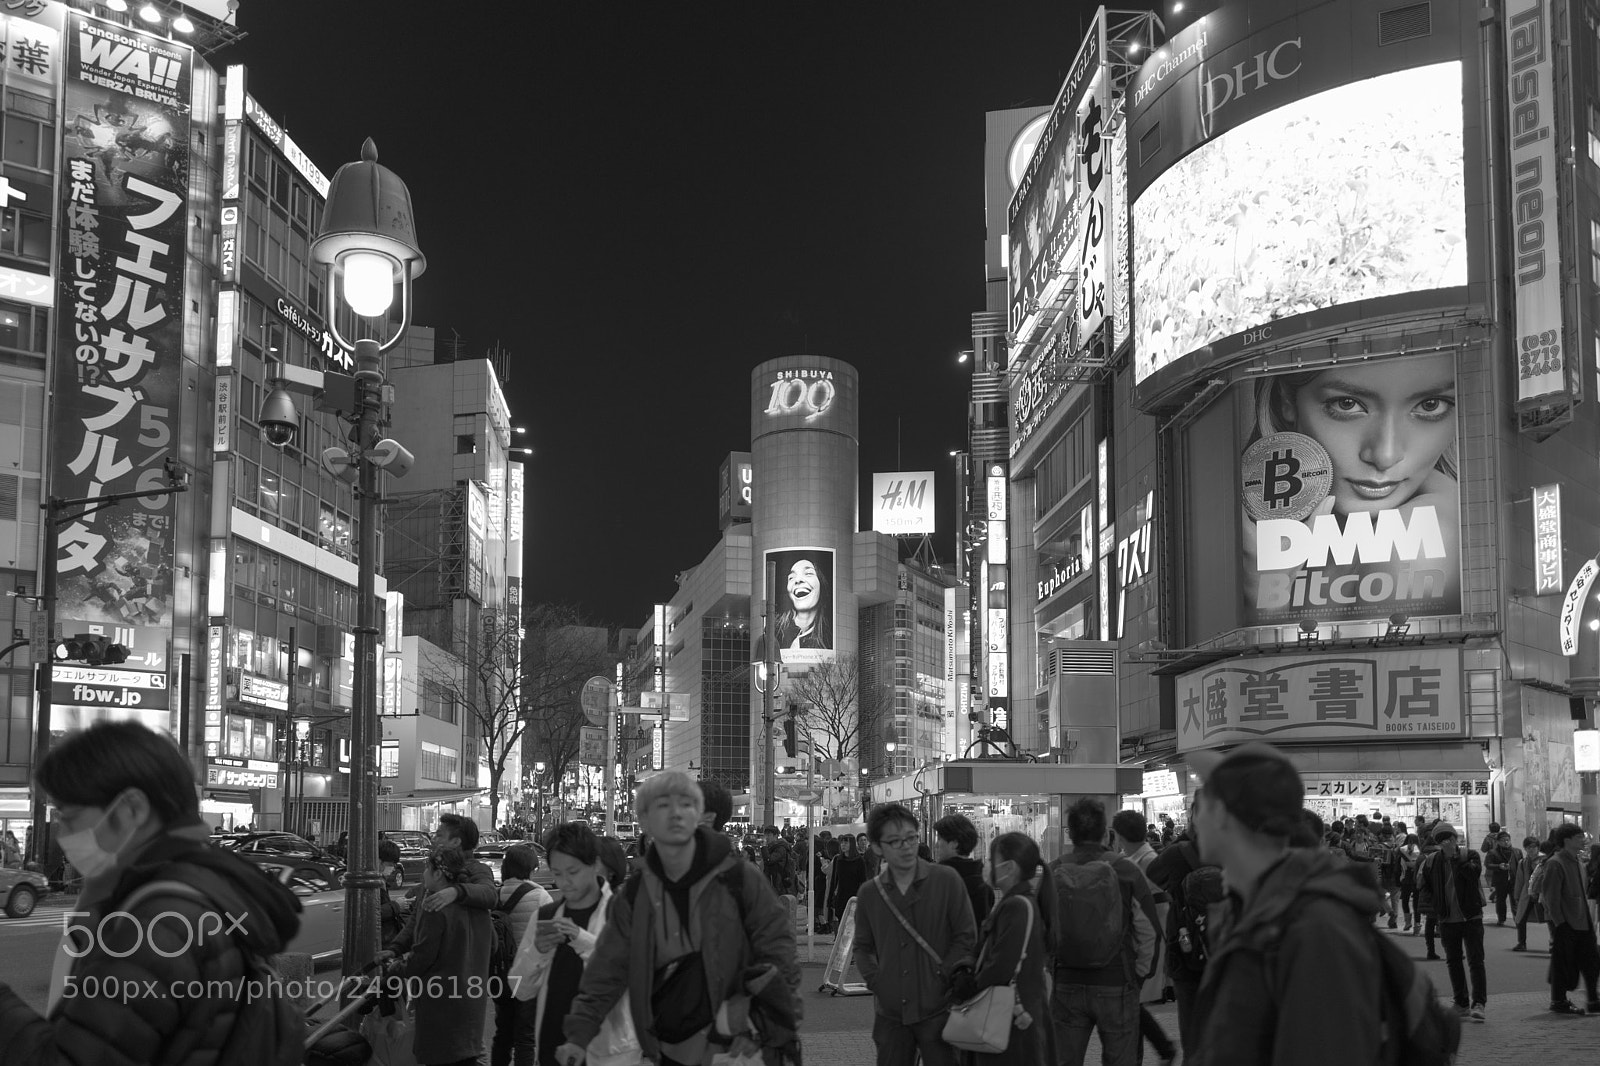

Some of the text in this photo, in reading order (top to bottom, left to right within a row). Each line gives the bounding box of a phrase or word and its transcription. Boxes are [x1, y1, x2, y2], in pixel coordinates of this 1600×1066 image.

[80, 20, 182, 61] Panasonic presents
[80, 63, 178, 98] Wonder Japan Experience
[1133, 32, 1207, 108] DHC Channel
[1203, 36, 1303, 118] DHC
[80, 71, 179, 107] FUERZA BRUTA
[1012, 34, 1096, 224] JAPAN DEBUT SINGLE
[1515, 155, 1546, 287] neon
[222, 238, 235, 275] ガスト
[1012, 249, 1048, 334] DAY6
[321, 331, 354, 371] ガスト
[1243, 326, 1272, 346] DHC
[1521, 329, 1557, 352] (03)
[1520, 345, 1560, 367] 3719
[777, 370, 833, 380] SHIBUYA
[218, 382, 229, 447] 渋谷駅前ビル
[1245, 479, 1263, 488] DMM
[1302, 469, 1328, 479] Bitcoin
[511, 468, 521, 541] BIC CAMERA
[881, 479, 928, 511] H&M
[132, 512, 170, 530] まで!
[1256, 505, 1447, 571] DMM
[1538, 491, 1558, 590] 大盛堂商事ビル
[990, 581, 1006, 591] JTB
[1038, 557, 1081, 600] Euphoria
[1256, 563, 1447, 610] Bitcoin
[1563, 565, 1592, 653] 渋谷センター街
[73, 684, 143, 706] fbw.jp
[960, 682, 968, 714] MIZUHO
[1182, 665, 1442, 735] 大盛堂書店
[1386, 722, 1456, 737] BOOKS TAISEIDO
[227, 771, 267, 788] サンドラッグ
[1459, 780, 1489, 796] 発売
